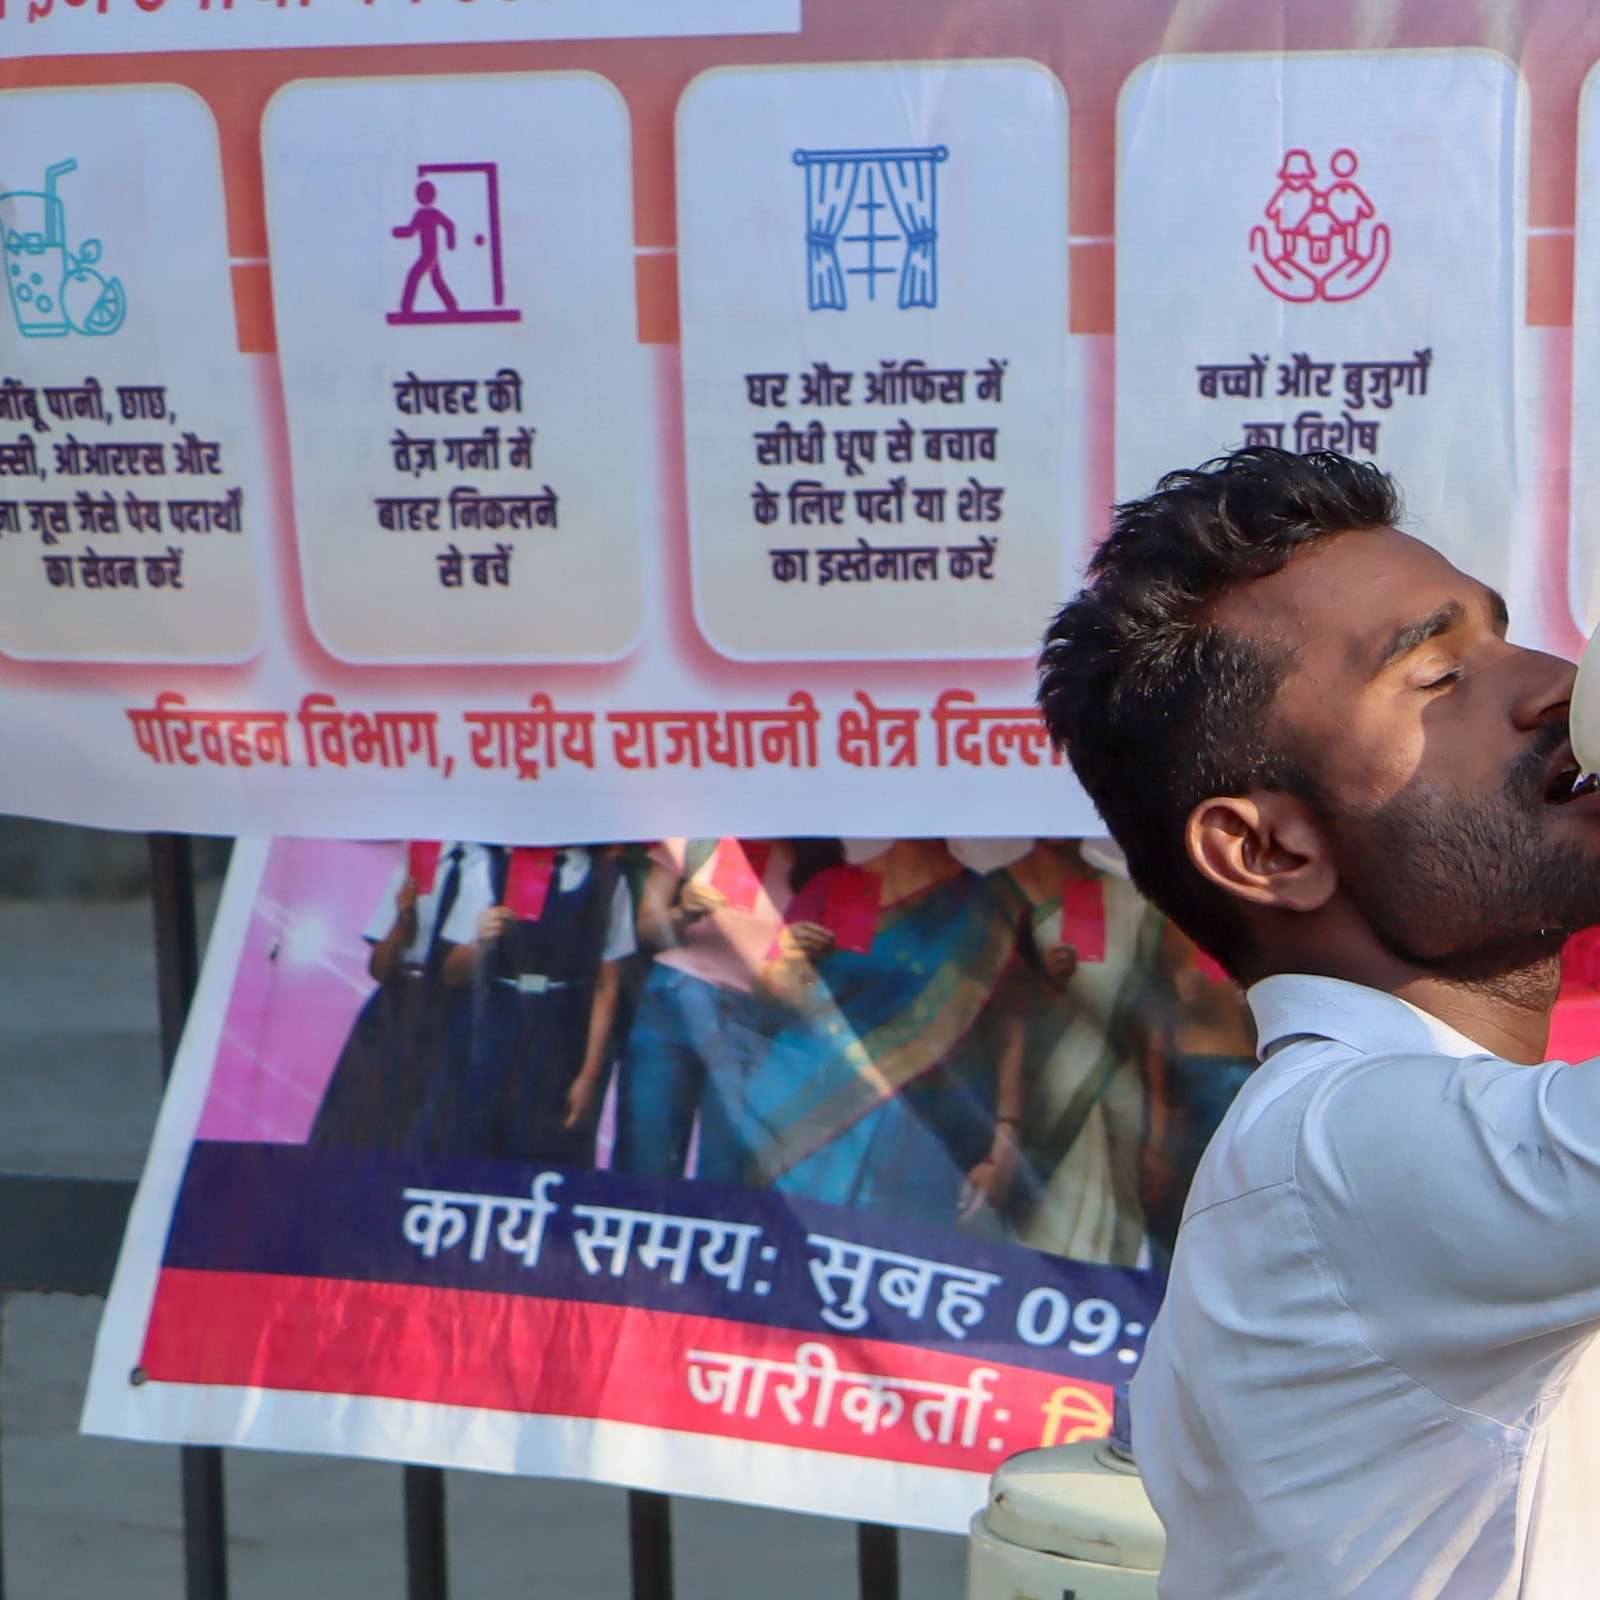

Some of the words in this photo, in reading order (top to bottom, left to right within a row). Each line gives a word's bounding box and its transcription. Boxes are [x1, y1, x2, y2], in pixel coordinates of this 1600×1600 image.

[393, 372, 478, 414] दोपहर
[484, 369, 522, 413] की
[745, 374, 789, 407] घर
[800, 363, 853, 406] और
[865, 360, 966, 404] ऑफिस
[974, 359, 1008, 402] में
[1197, 354, 1269, 399] बच्चों
[1277, 353, 1335, 397] और
[1342, 348, 1432, 409] बुजुर्गों
[116, 386, 175, 424] छाछ,
[53, 433, 165, 476] ओआरएस
[173, 433, 221, 474] और
[390, 429, 436, 477] तेज़
[442, 427, 500, 470] गर्मी
[507, 427, 535, 469] में
[754, 420, 826, 465] सीधी
[833, 430, 877, 477] धूप
[884, 419, 915, 463] से
[922, 428, 998, 461] बचाव
[1289, 412, 1379, 460] विशेष
[24, 501, 70, 545] जूस
[73, 491, 119, 533] जैसे
[123, 491, 161, 533] पेय
[166, 487, 242, 533] पदार्थों
[374, 498, 440, 530] बाहर
[448, 485, 558, 529] निकलने
[751, 482, 780, 525] के
[787, 480, 846, 524] लिए
[854, 477, 906, 523] पर्दों
[912, 488, 946, 522] या
[958, 477, 1004, 522] शेड
[43, 556, 74, 587] का
[77, 547, 138, 588] सेवन
[142, 547, 182, 589] करें
[437, 544, 464, 587] से
[469, 544, 513, 586] बचें
[769, 549, 809, 582] का
[815, 538, 940, 586] इस्तेमाल
[946, 536, 997, 580] करें
[126, 691, 289, 767] परिवहन
[297, 693, 453, 778] विभाग,
[464, 692, 595, 780] राष्ट्रीय
[607, 689, 820, 768] राजधानी
[838, 690, 920, 767] क्षेत्र
[932, 685, 1068, 766] दिल्ल
[404, 1172, 563, 1267] कार्य
[573, 1205, 776, 1294] समय:
[808, 1234, 1001, 1338] सुबह
[1017, 1288, 1143, 1364] 09:
[682, 1343, 1009, 1457] जारीकर्ता:
